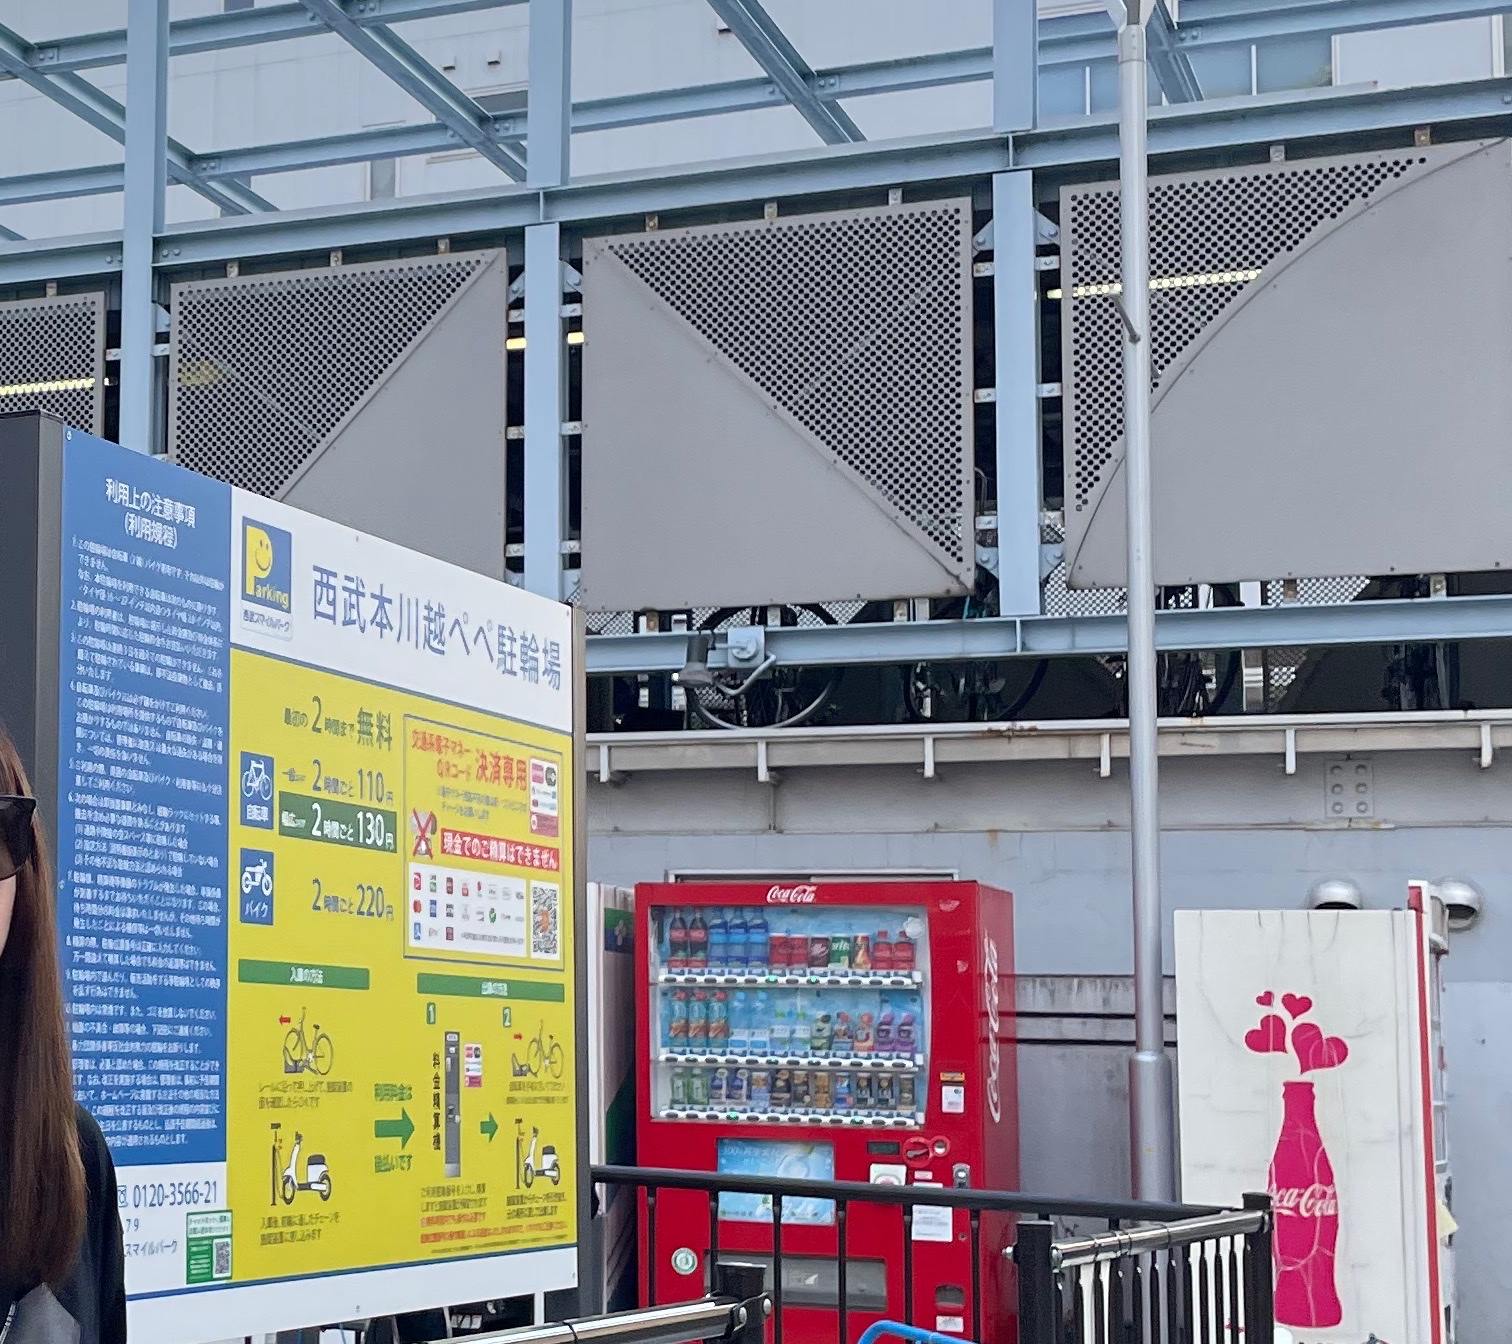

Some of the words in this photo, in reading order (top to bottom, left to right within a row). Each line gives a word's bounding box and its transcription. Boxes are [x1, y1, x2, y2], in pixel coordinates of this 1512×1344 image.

[105, 478, 196, 528] 利用上の注意事項
[312, 564, 561, 692] 西武本川越ペペ駐輪場
[475, 748, 527, 791] 決済専用
[443, 831, 558, 870] 現金でのご精算はできません
[245, 899, 268, 918] バイク
[766, 885, 817, 903] Coca-Cola
[133, 1180, 217, 1209] 0120-3566-21
